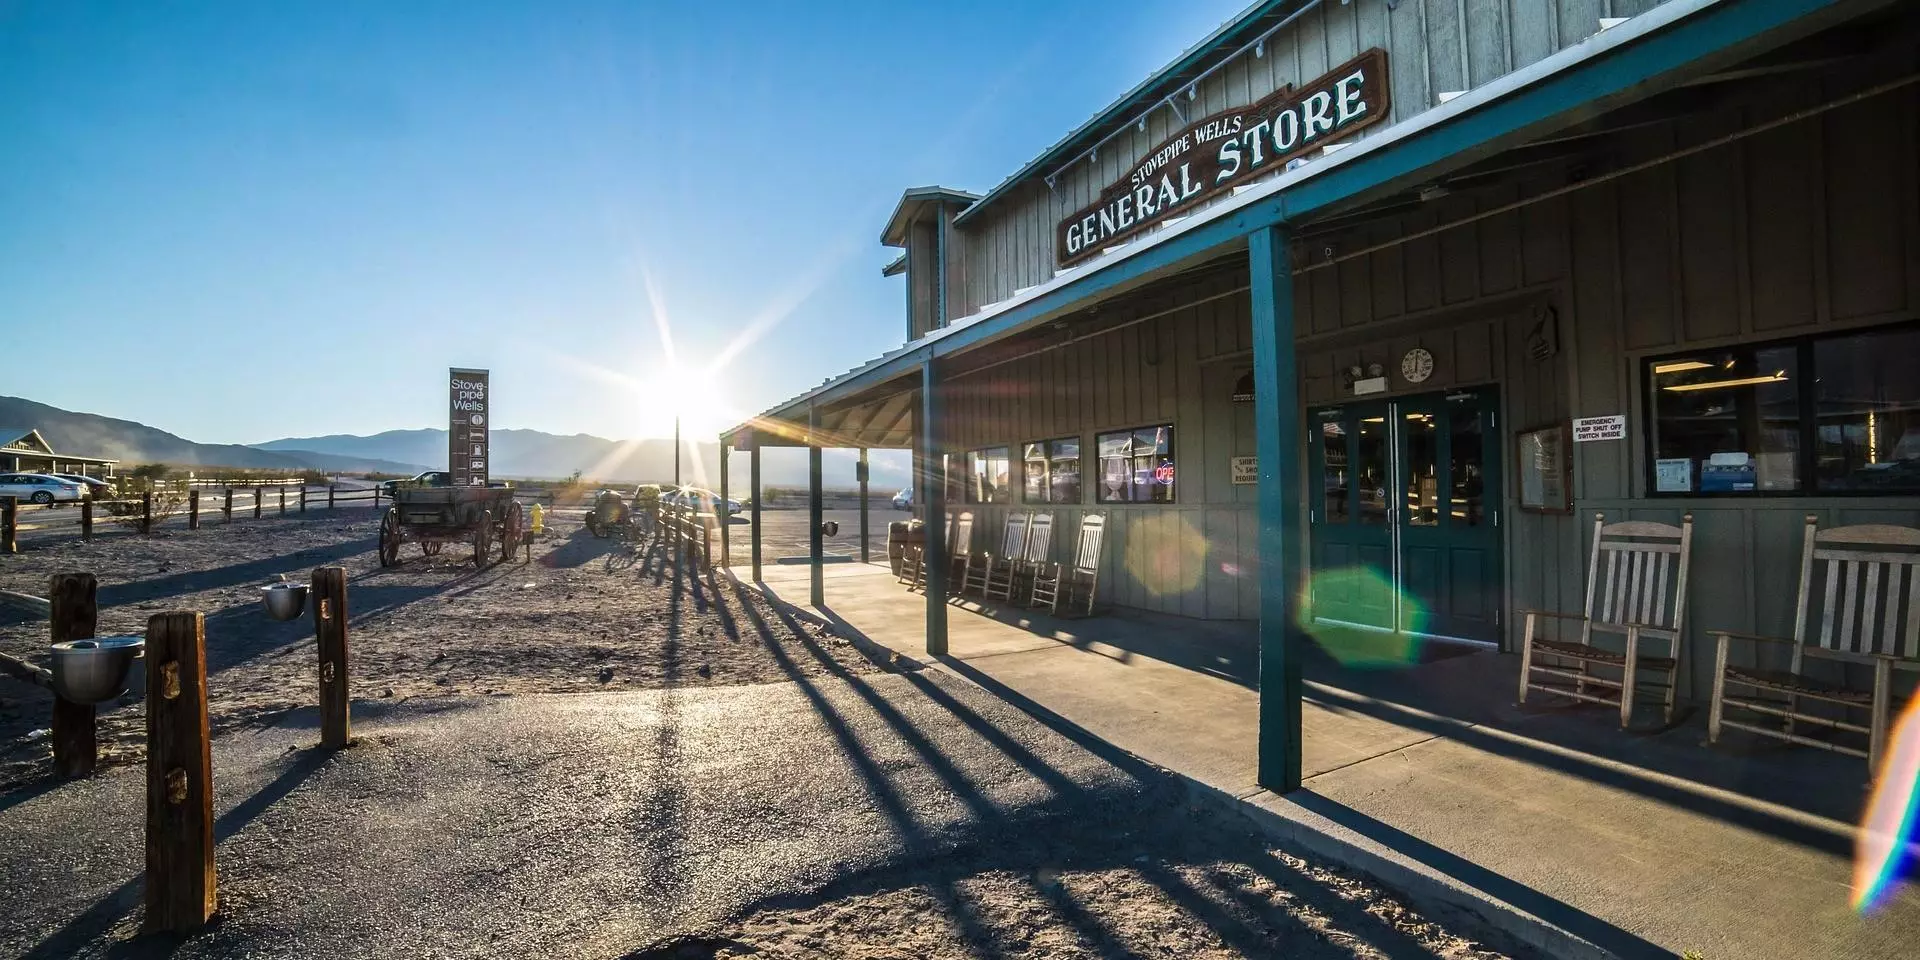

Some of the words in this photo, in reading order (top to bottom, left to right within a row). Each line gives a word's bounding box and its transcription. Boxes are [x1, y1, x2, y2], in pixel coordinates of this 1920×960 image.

[1132, 133, 1190, 190] STOVEPIPE
[1195, 115, 1242, 145] WELLS
[1066, 162, 1201, 255] GENERAL
[1215, 69, 1367, 184] STORE
[451, 379, 487, 390] Stove-
[460, 390, 484, 400] pipe
[453, 399, 484, 411] Wells
[1156, 467, 1174, 481] OPE
[1245, 466, 1258, 474] SHO
